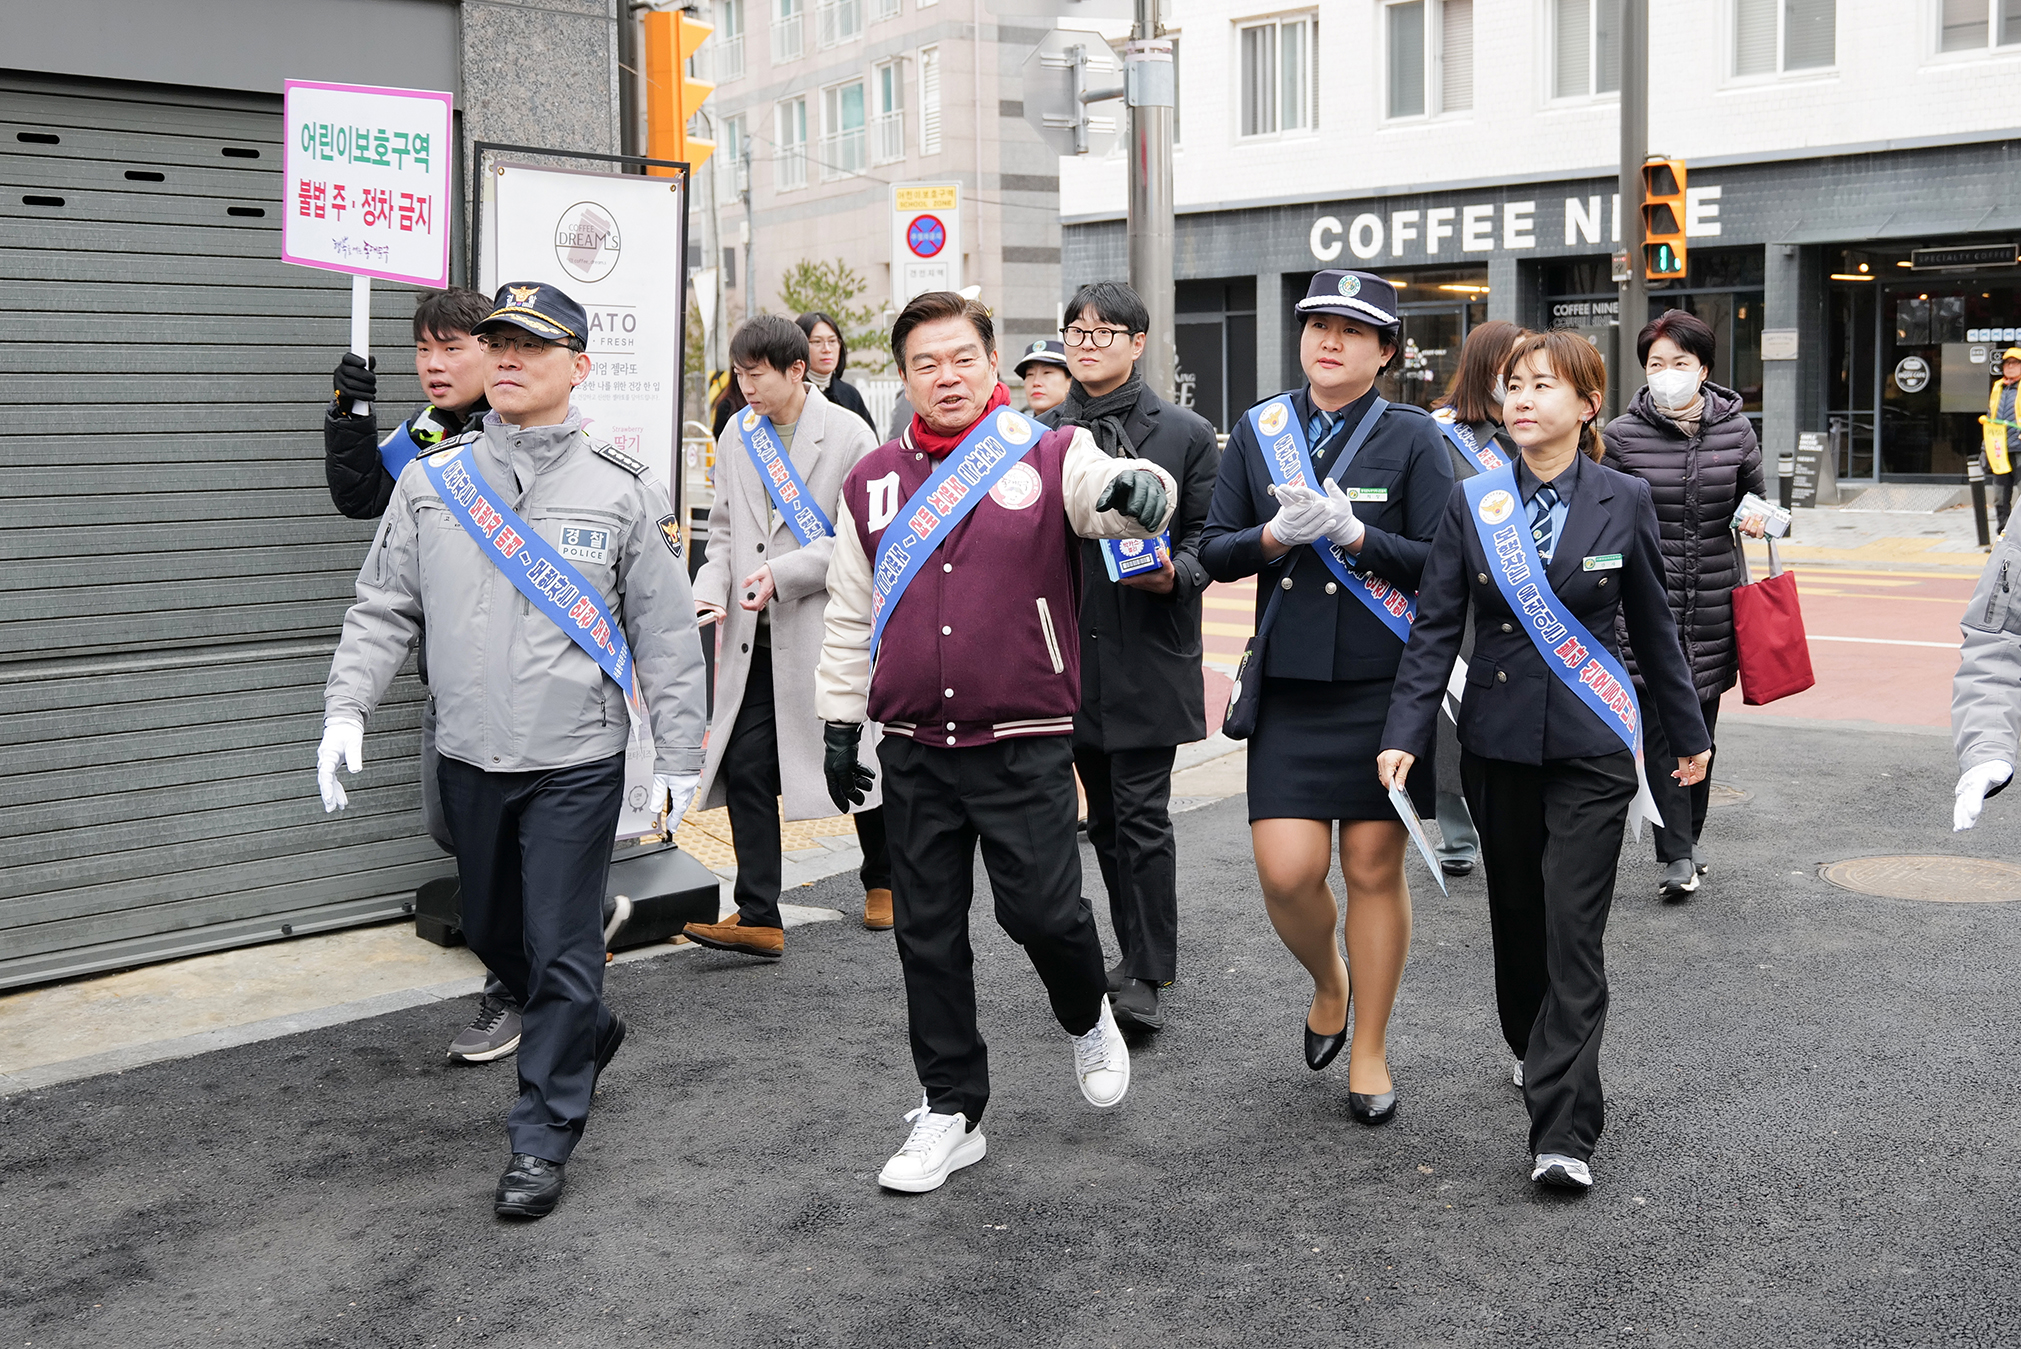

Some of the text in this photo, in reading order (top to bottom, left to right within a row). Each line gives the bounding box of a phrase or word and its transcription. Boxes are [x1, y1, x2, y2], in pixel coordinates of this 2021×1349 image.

[301, 121, 430, 174] 어린이보호구역
[897, 189, 954, 199] 어린이보호구역
[298, 178, 327, 219] 불법
[398, 192, 432, 235] 금지
[569, 224, 594, 233] COFFEE
[1310, 186, 1722, 261] COFFEE NIE
[1918, 251, 2012, 263] SPECIALTY COFFEE
[910, 269, 944, 278] 견인지역
[1553, 302, 1619, 316] COFFEE NINE
[589, 312, 637, 333] ATO
[600, 337, 634, 346] FRESH
[591, 362, 638, 376] 미엄 젤라또
[597, 382, 611, 391] 나를
[613, 382, 626, 391] 위한
[629, 382, 641, 391] 건강
[643, 382, 651, 391] 한
[653, 381, 660, 391] 입
[612, 425, 644, 434] Strawberry
[614, 435, 640, 453] 딸기
[751, 427, 777, 464] 운전자는
[766, 456, 790, 488] 보행자
[957, 435, 1007, 486] 운전자는
[1272, 433, 1302, 480] 운전자는
[866, 471, 900, 534] D
[926, 473, 970, 516] 보행자
[442, 459, 477, 507] 운전자는
[468, 494, 503, 539] 보행자
[526, 557, 580, 609] 보행자는
[568, 595, 600, 629] 안전
[563, 547, 603, 560] POLICE
[875, 543, 910, 595] 보행자는
[1492, 524, 1529, 586] 보행자는
[1516, 583, 1569, 645] 움직이는
[1554, 635, 1588, 669] 빨간
[1579, 657, 1637, 734] 신호등입니다
[627, 750, 652, 761] 코타치즈
